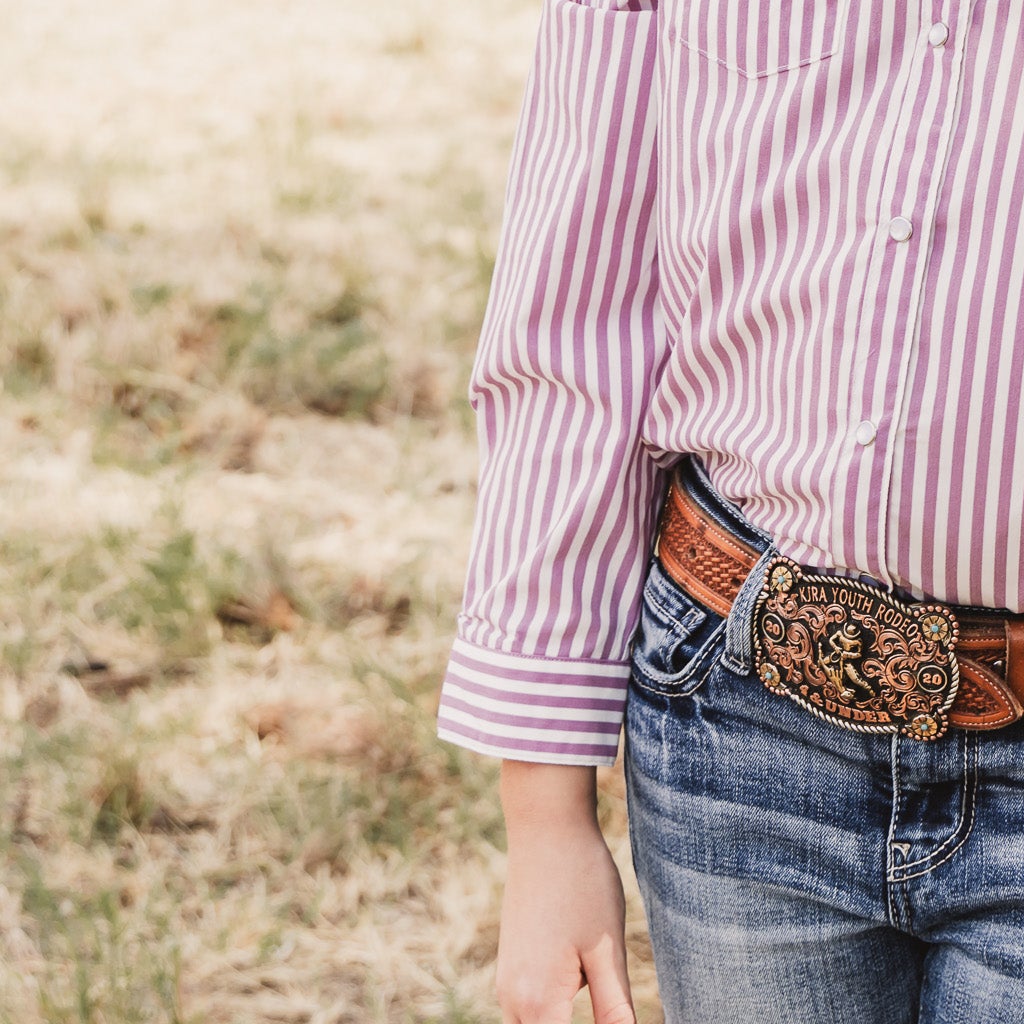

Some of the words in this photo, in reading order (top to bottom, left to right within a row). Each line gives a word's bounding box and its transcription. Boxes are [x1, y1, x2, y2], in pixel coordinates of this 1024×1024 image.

[799, 586, 828, 603] KJRA
[832, 587, 873, 613] YOUTH
[875, 603, 918, 637] RODEO
[765, 620, 780, 636] 20
[922, 673, 943, 685] 20
[810, 692, 824, 707] &
[825, 699, 892, 723] UNDER
